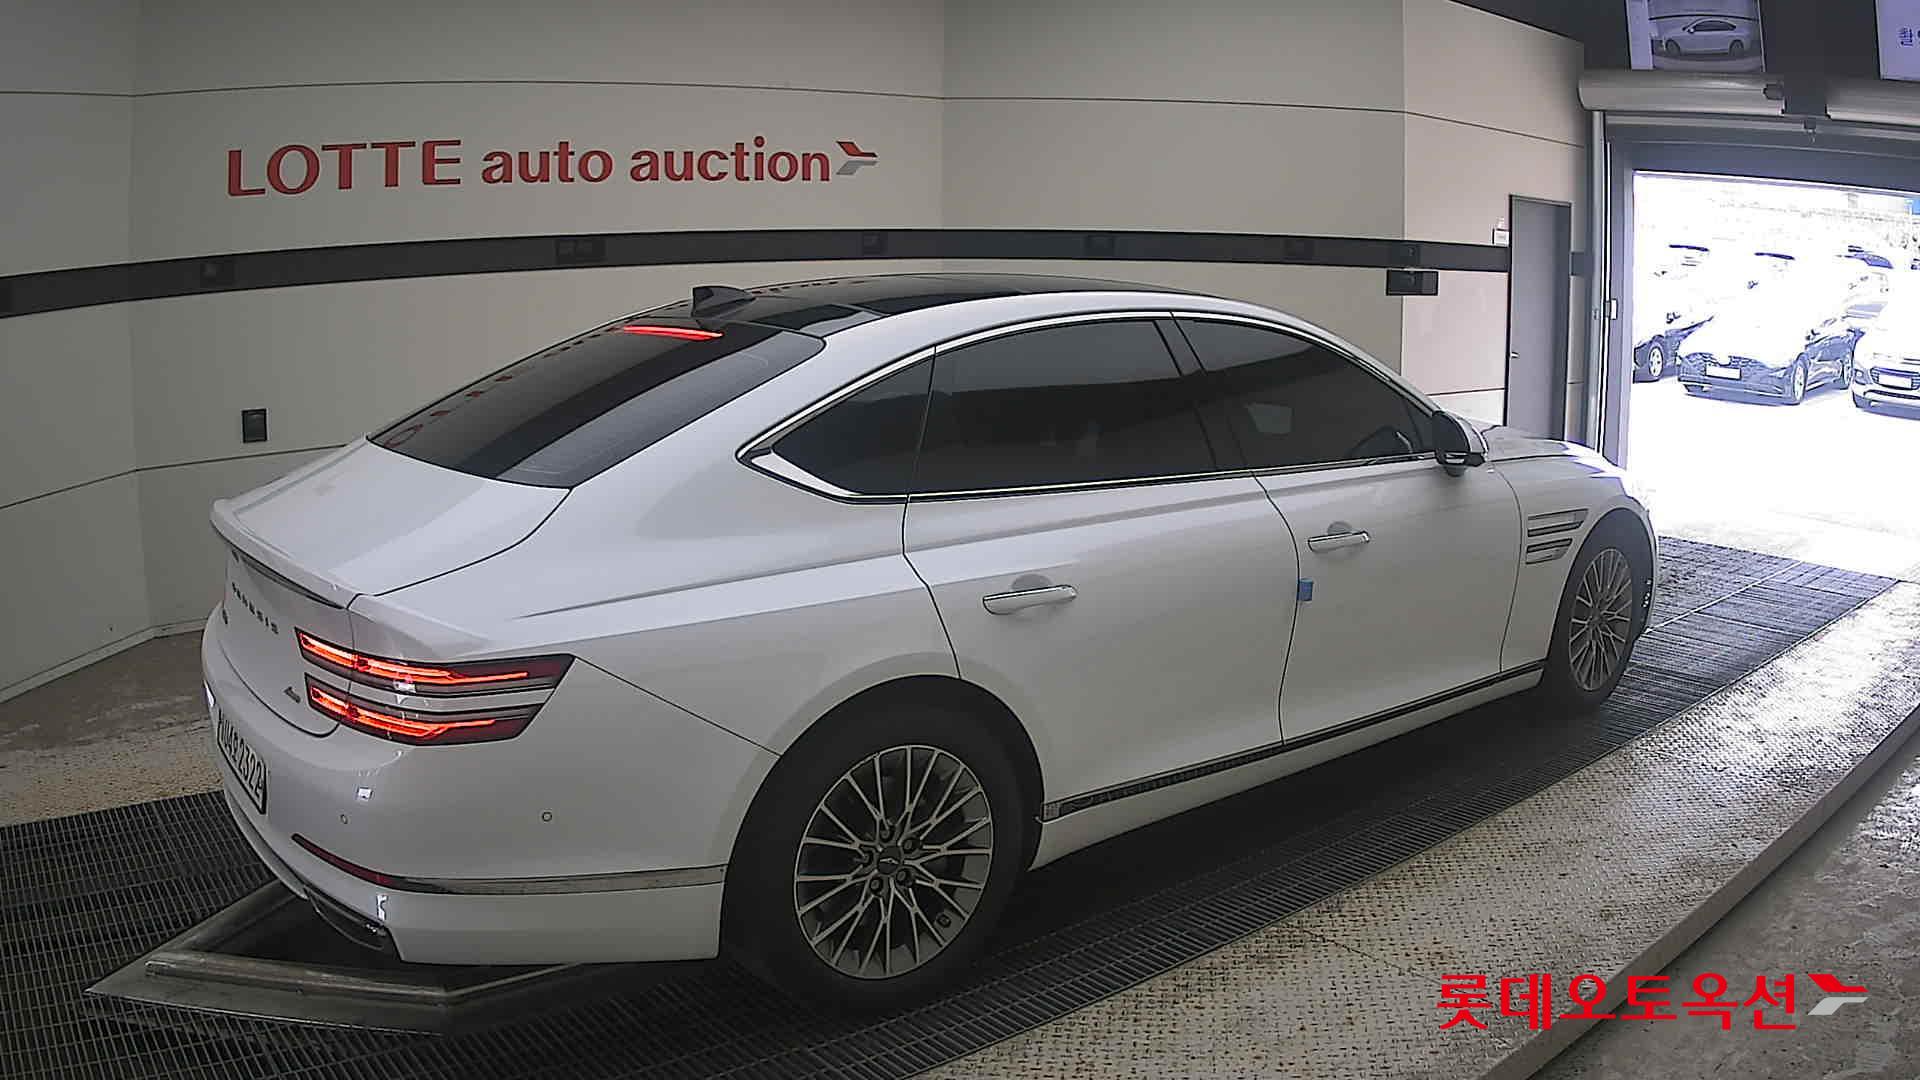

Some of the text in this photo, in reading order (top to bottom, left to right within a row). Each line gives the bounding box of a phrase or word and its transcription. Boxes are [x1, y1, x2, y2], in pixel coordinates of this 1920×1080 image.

[228, 137, 831, 197] LOTTE auto auction
